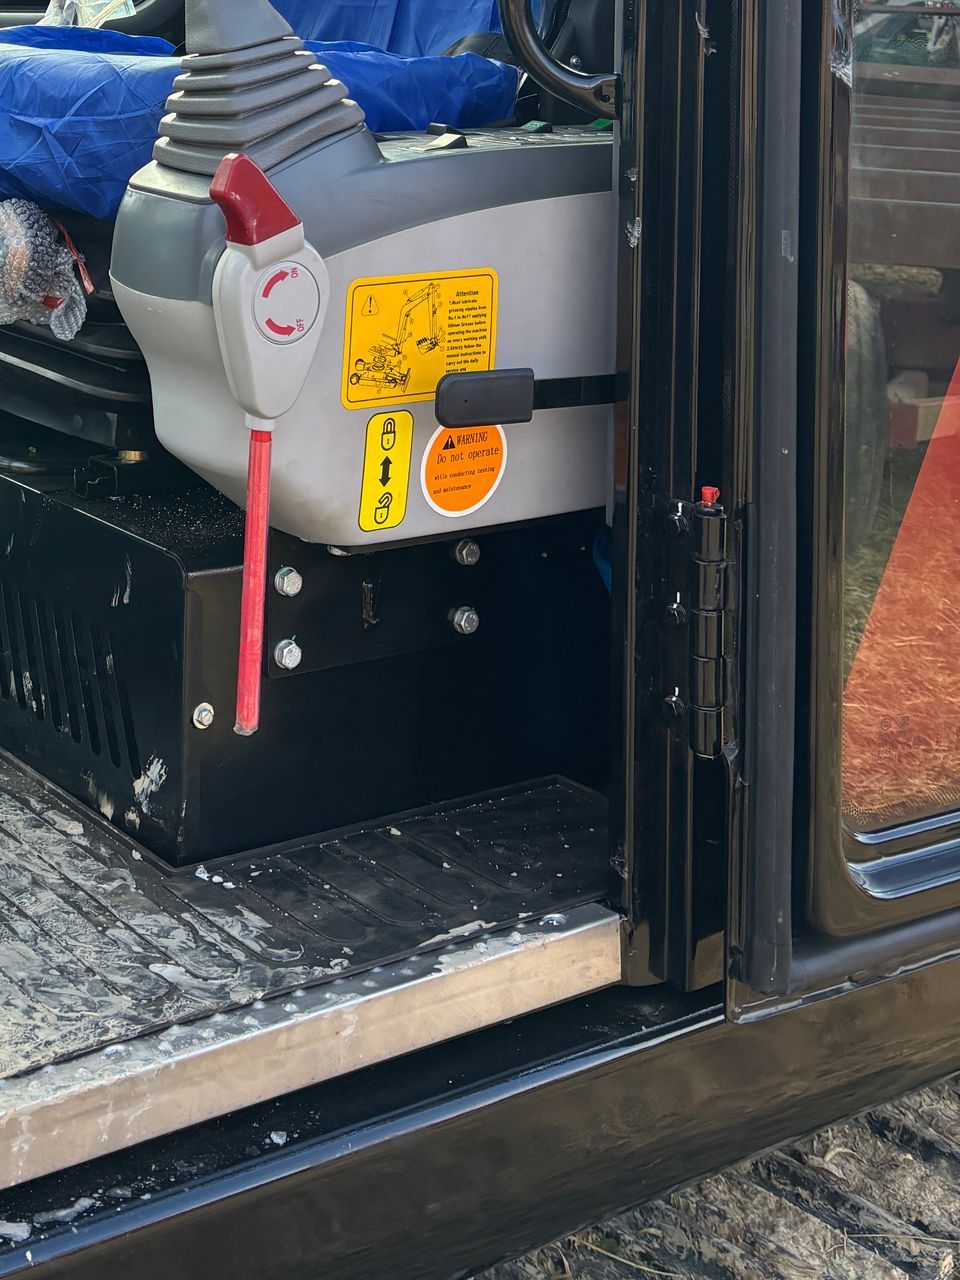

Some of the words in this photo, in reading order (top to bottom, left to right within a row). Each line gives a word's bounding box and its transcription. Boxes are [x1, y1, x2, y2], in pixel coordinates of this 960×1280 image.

[290, 267, 298, 278] ON
[296, 318, 304, 332] OFF
[456, 431, 488, 445] WARNING
[437, 454, 446, 464] Do
[450, 452, 464, 462] not
[468, 447, 499, 460] operate
